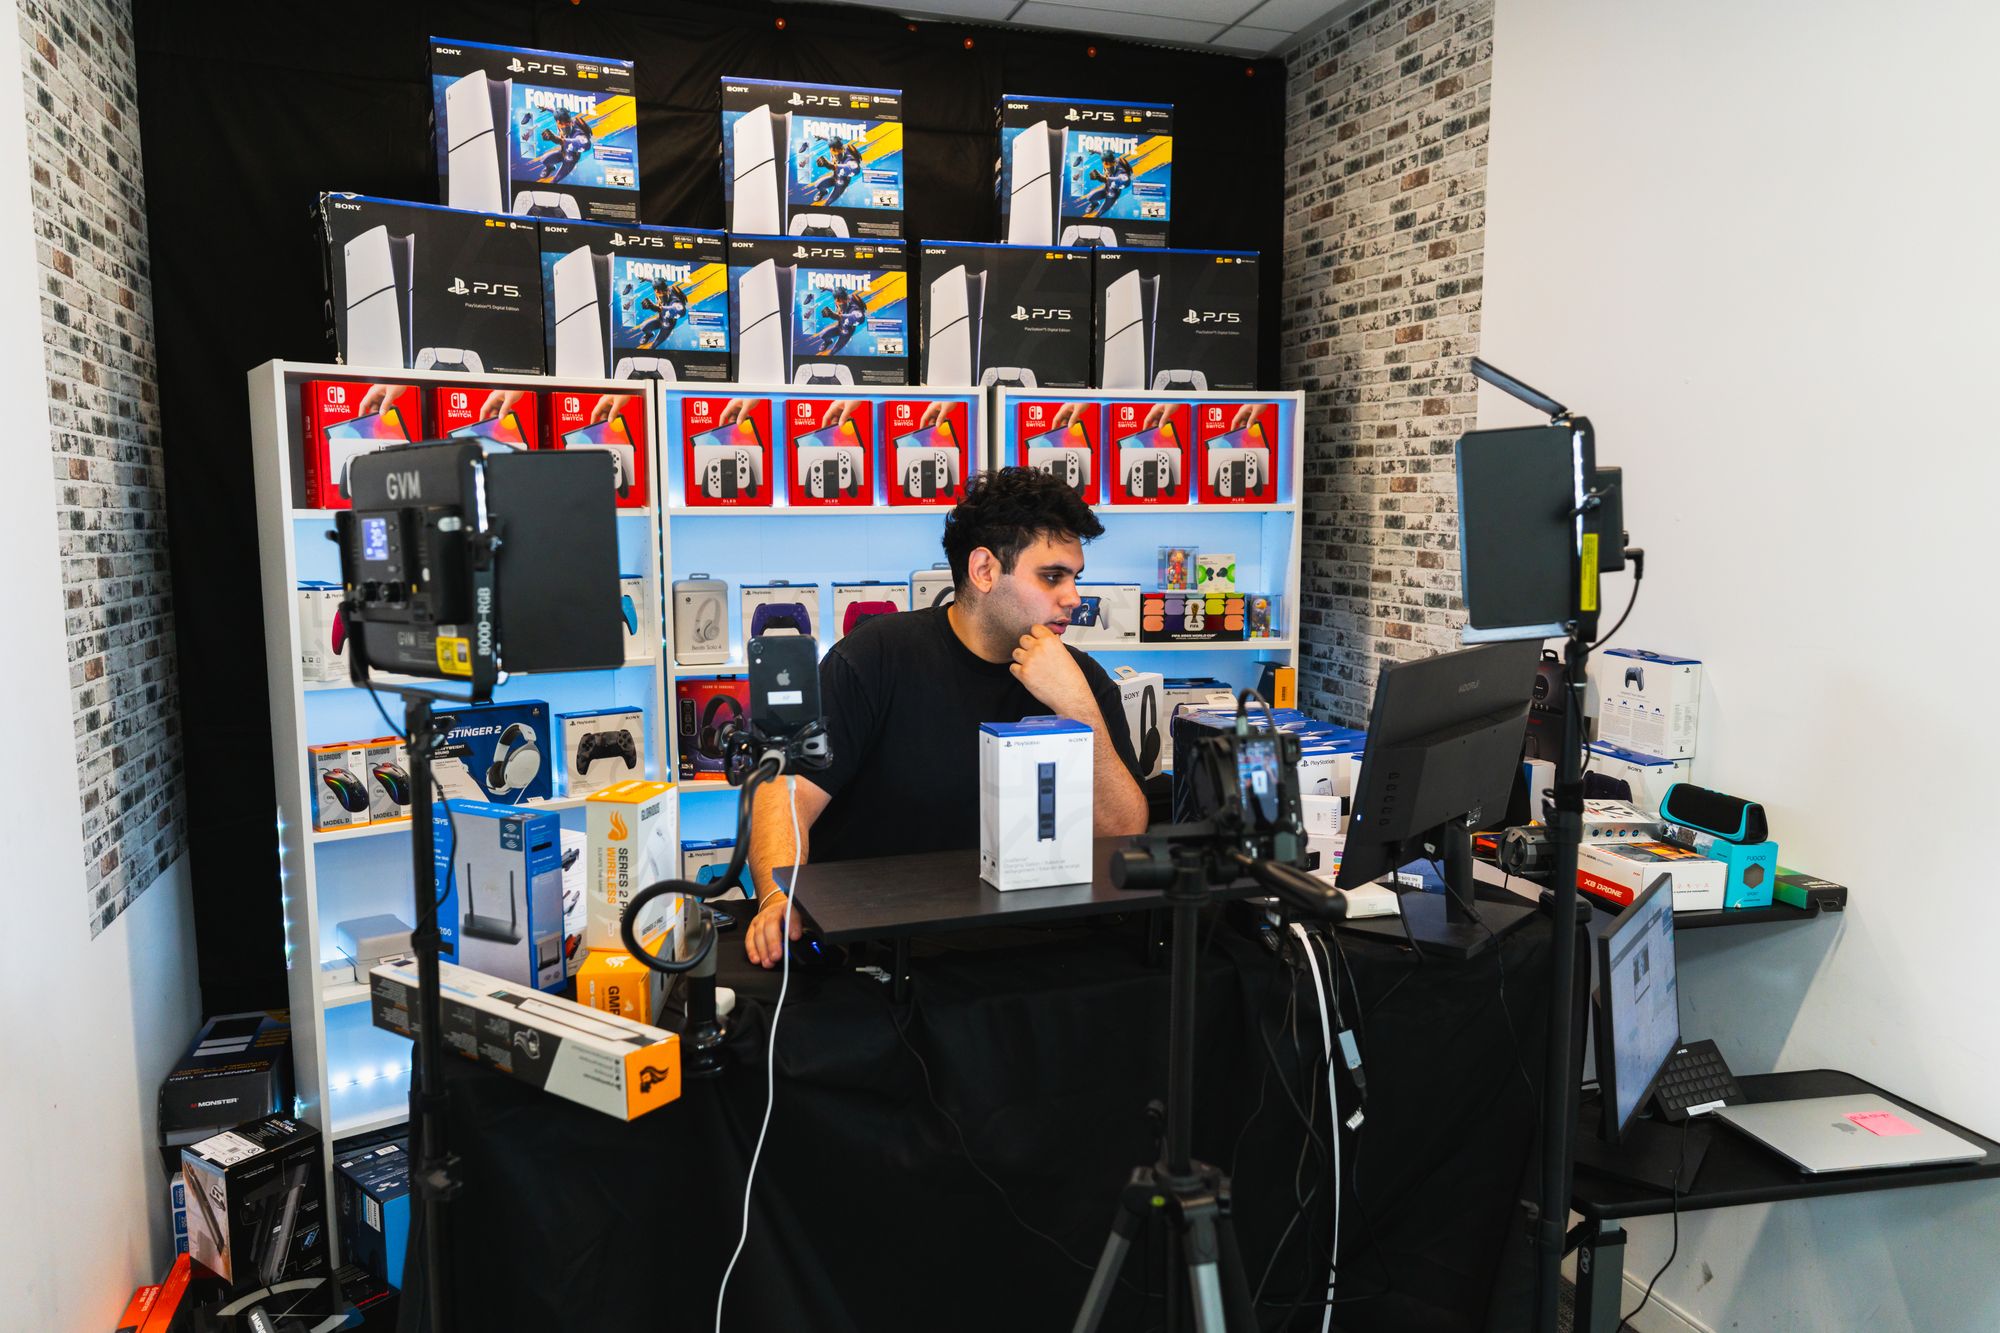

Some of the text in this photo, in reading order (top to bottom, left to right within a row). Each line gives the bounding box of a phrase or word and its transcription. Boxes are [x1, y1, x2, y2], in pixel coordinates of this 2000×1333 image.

[436, 47, 462, 55] SONY
[527, 62, 567, 76] PS5
[524, 87, 597, 115] FORTNITE
[806, 95, 841, 107] PS5
[1082, 111, 1115, 121] PS5
[802, 119, 867, 142] FORTNITE
[1077, 134, 1138, 155] FORTNITE
[335, 202, 361, 211] SONY
[628, 236, 664, 247] PS5
[811, 248, 846, 258] PS5
[626, 260, 692, 284] FORTNITE
[807, 271, 872, 292] FORTNITE
[473, 282, 520, 298] PS5
[1032, 309, 1072, 320] PS5
[1203, 312, 1241, 323] PS5
[386, 470, 421, 500] GVM
[1124, 691, 1140, 700] SONY
[447, 725, 502, 739] STINGER 2
[323, 818, 344, 826] MODEL
[618, 847, 628, 888] SERIES
[606, 847, 616, 904] WIRELESS
[1597, 882, 1623, 898] DRONE
[197, 1098, 238, 1108] MONSTER
